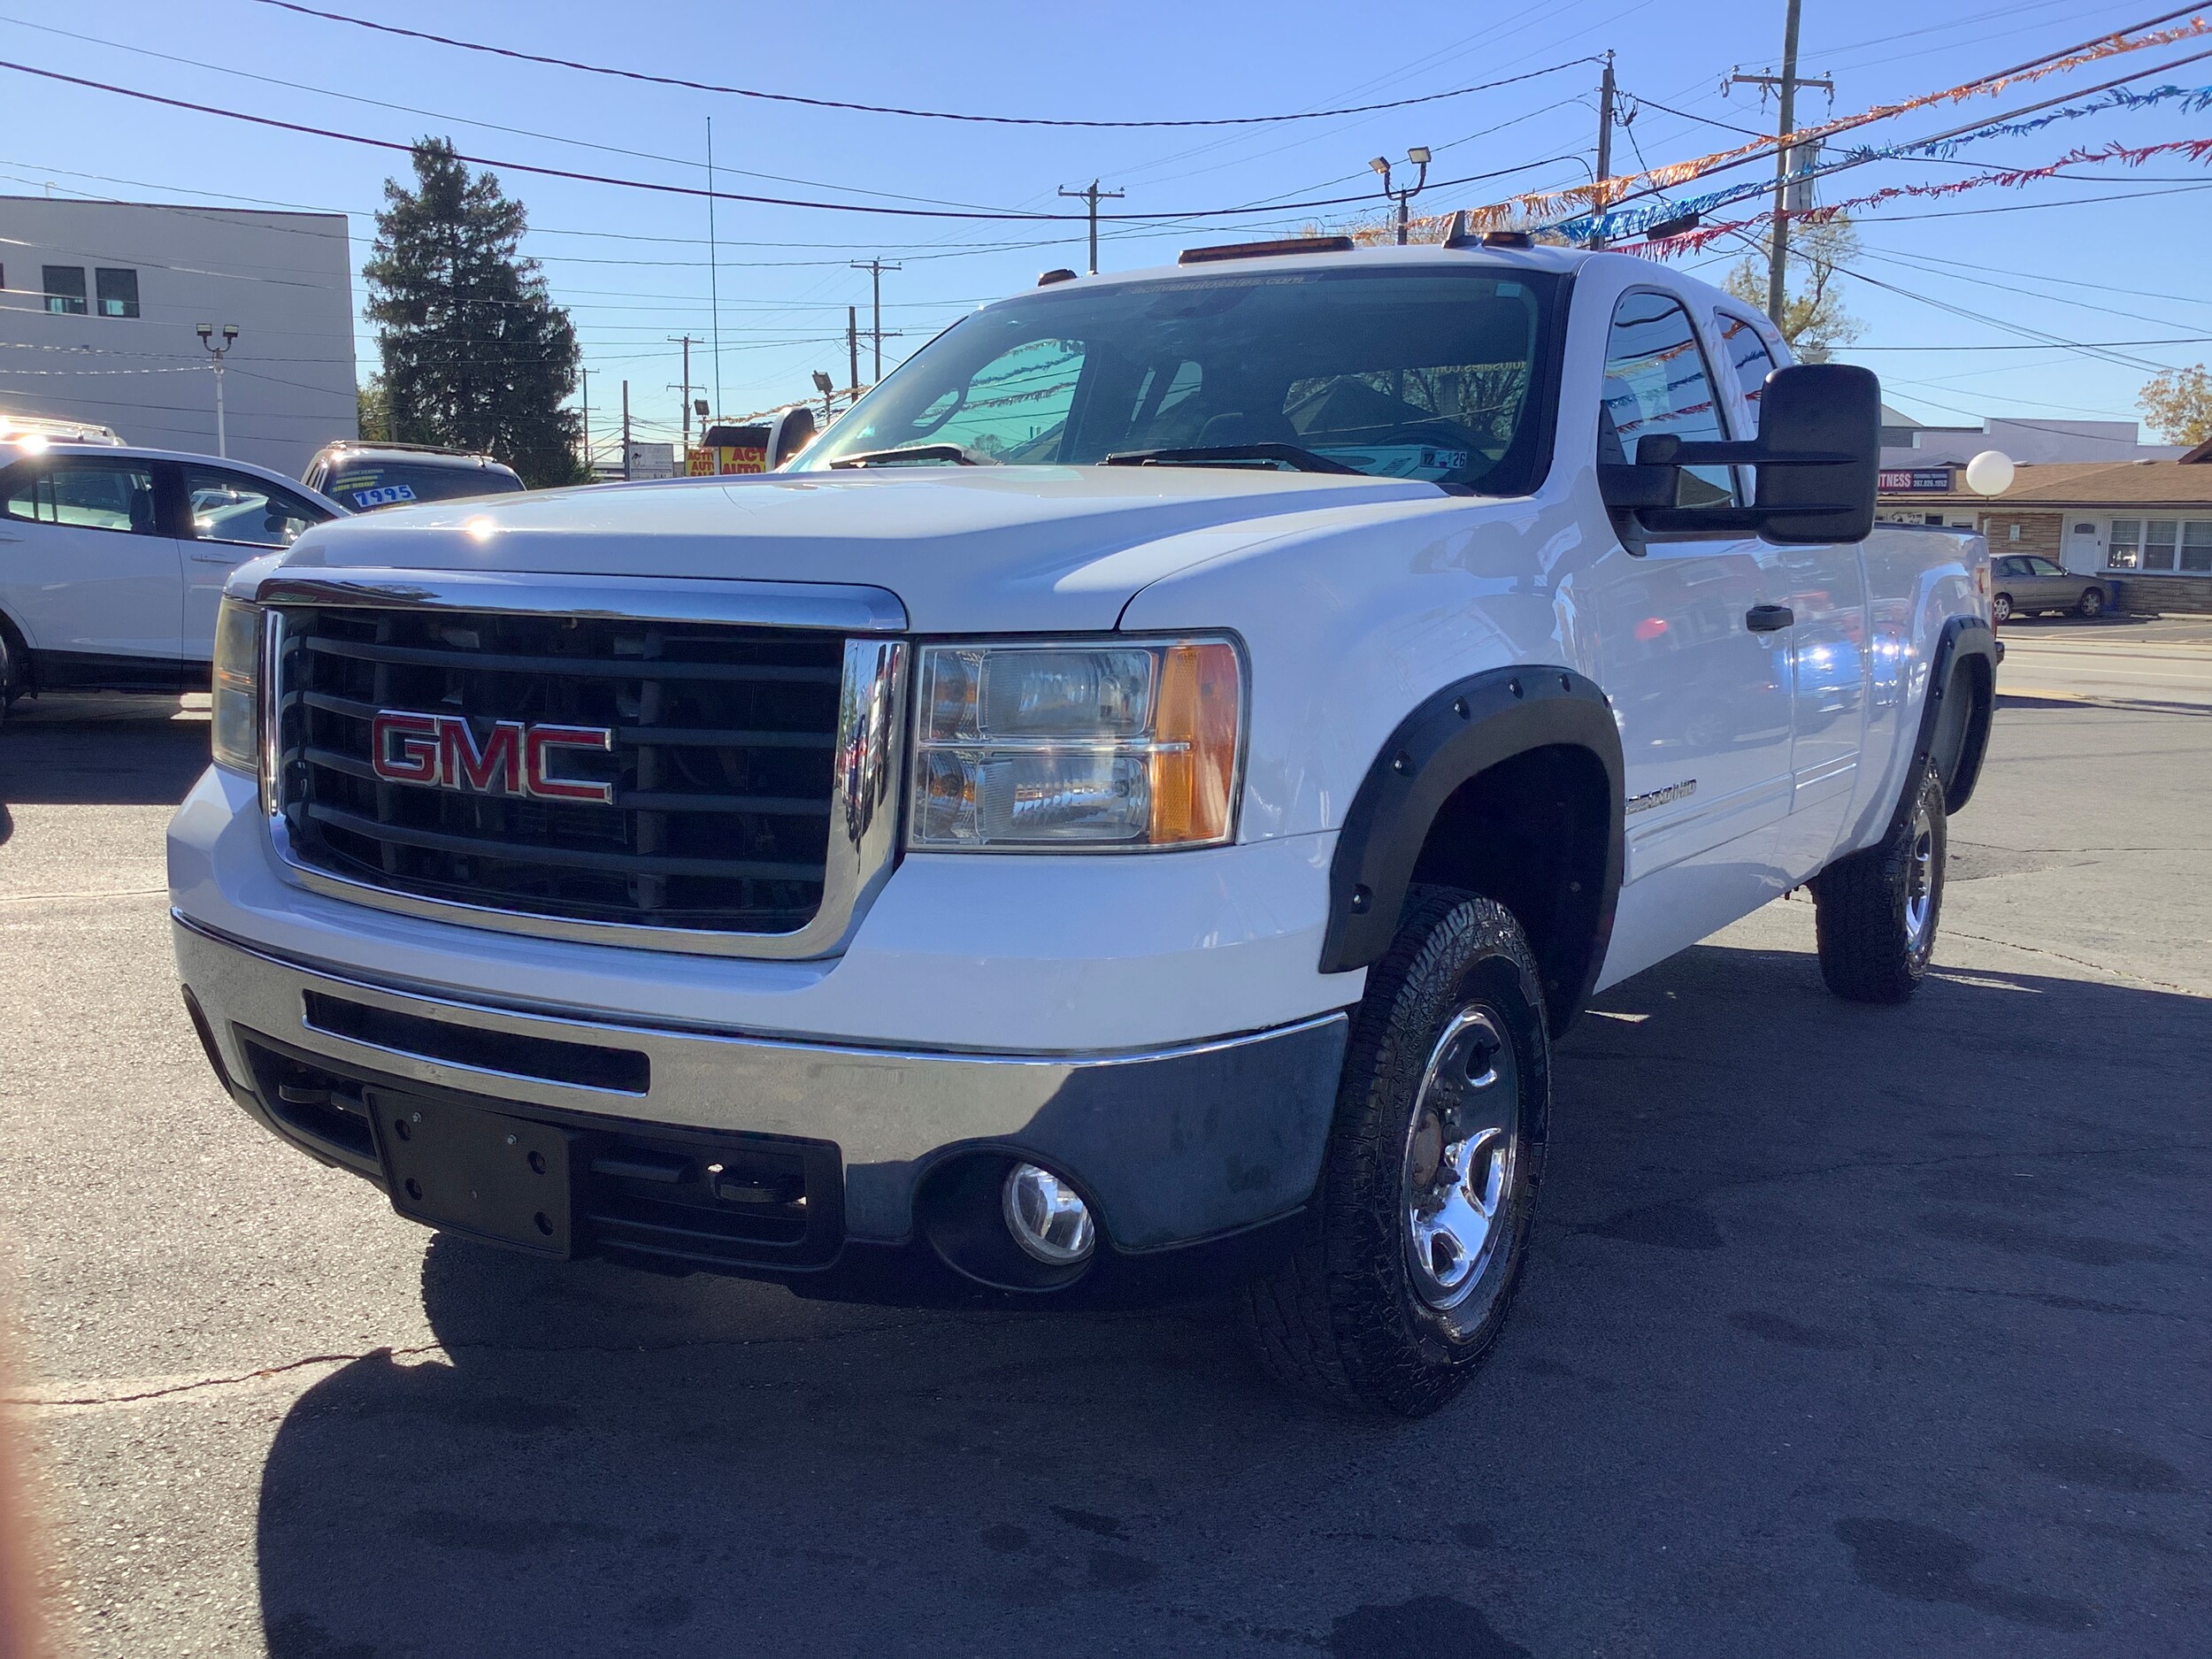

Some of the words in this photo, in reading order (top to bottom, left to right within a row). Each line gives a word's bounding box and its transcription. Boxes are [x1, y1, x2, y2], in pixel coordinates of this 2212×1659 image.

[733, 448, 765, 461] ACT
[1453, 452, 1466, 467] 26
[691, 461, 714, 471] AUT
[723, 464, 761, 474] AUTO
[1878, 473, 1911, 488] ITNESS
[356, 486, 411, 505] 7995
[373, 710, 612, 805] GMC
